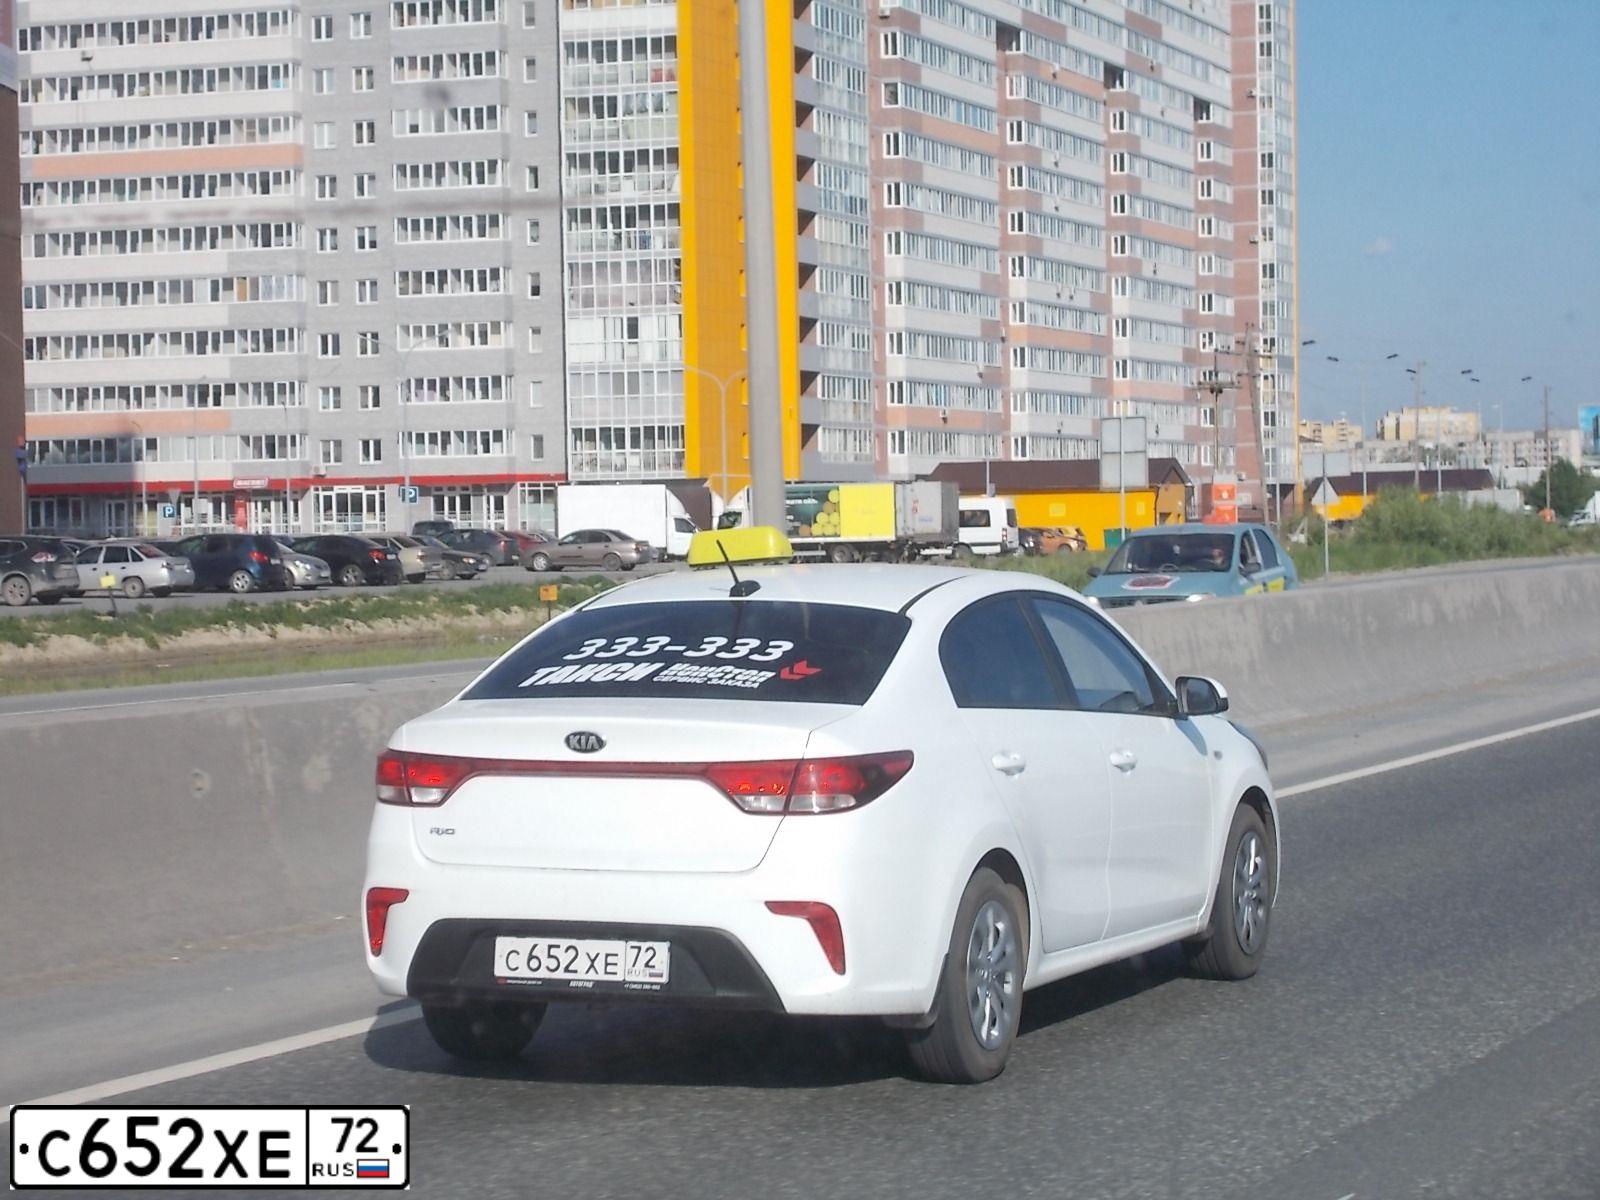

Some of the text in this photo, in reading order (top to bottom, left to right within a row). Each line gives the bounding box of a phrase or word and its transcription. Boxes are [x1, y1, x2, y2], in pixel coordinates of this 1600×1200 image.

[165, 506, 174, 518] P
[562, 635, 794, 662] 333-333
[518, 662, 665, 688] ТАКСИ
[706, 678, 760, 688] ЗАКАЗА
[568, 735, 601, 750] KIA
[629, 945, 657, 968] 72
